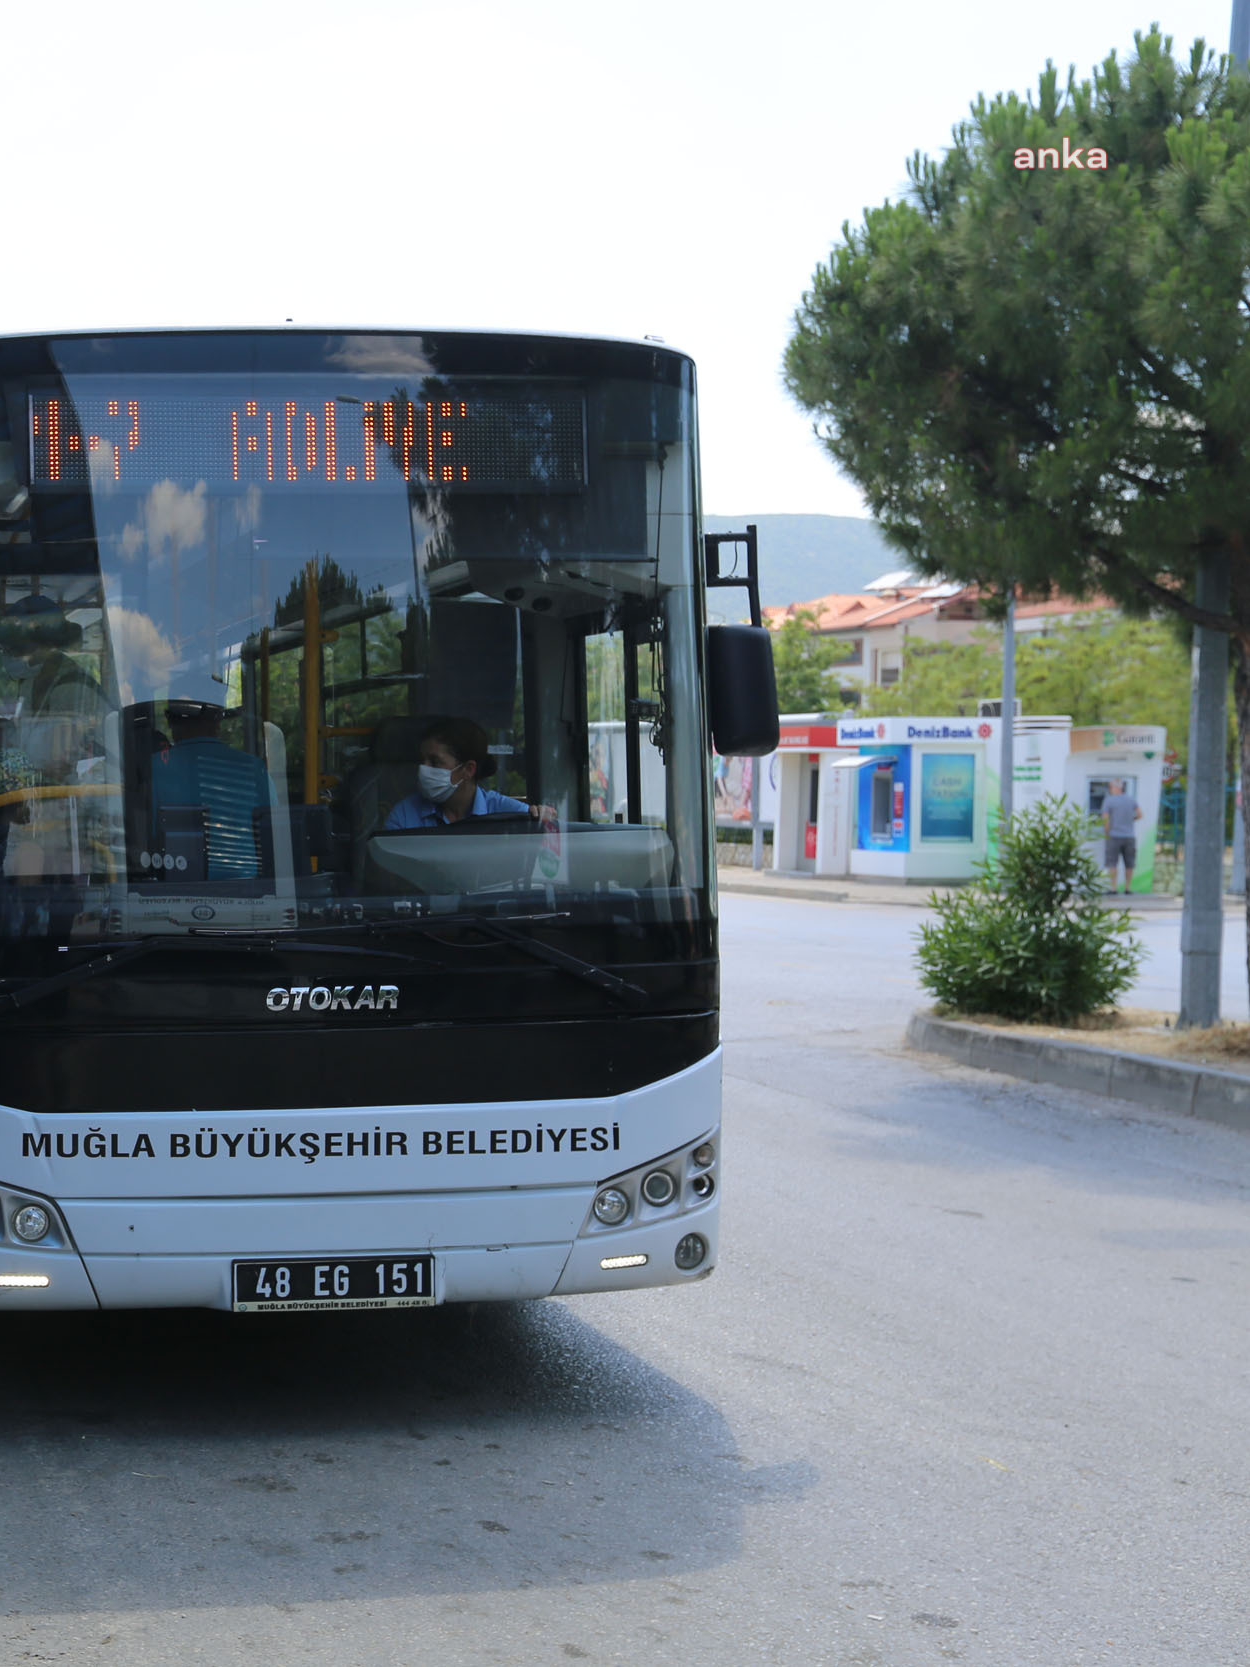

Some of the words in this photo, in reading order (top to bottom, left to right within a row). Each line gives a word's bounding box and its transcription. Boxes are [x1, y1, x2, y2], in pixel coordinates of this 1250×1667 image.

[840, 727, 875, 740] DenizBank
[907, 725, 974, 738] DenizBank
[265, 985, 400, 1012] OTOKAR
[21, 1127, 156, 1158] MUĞLA
[169, 1126, 408, 1164] BÜYÜKŞEHİR
[422, 1122, 621, 1155] BELEDİYESİ
[255, 1266, 291, 1298] 48
[314, 1264, 350, 1297] EG
[375, 1262, 423, 1295] 151
[257, 1303, 285, 1311] MUĞLA
[287, 1301, 339, 1310] BÜYÜKŞEHİR
[341, 1300, 387, 1308] BELEDİYESİ
